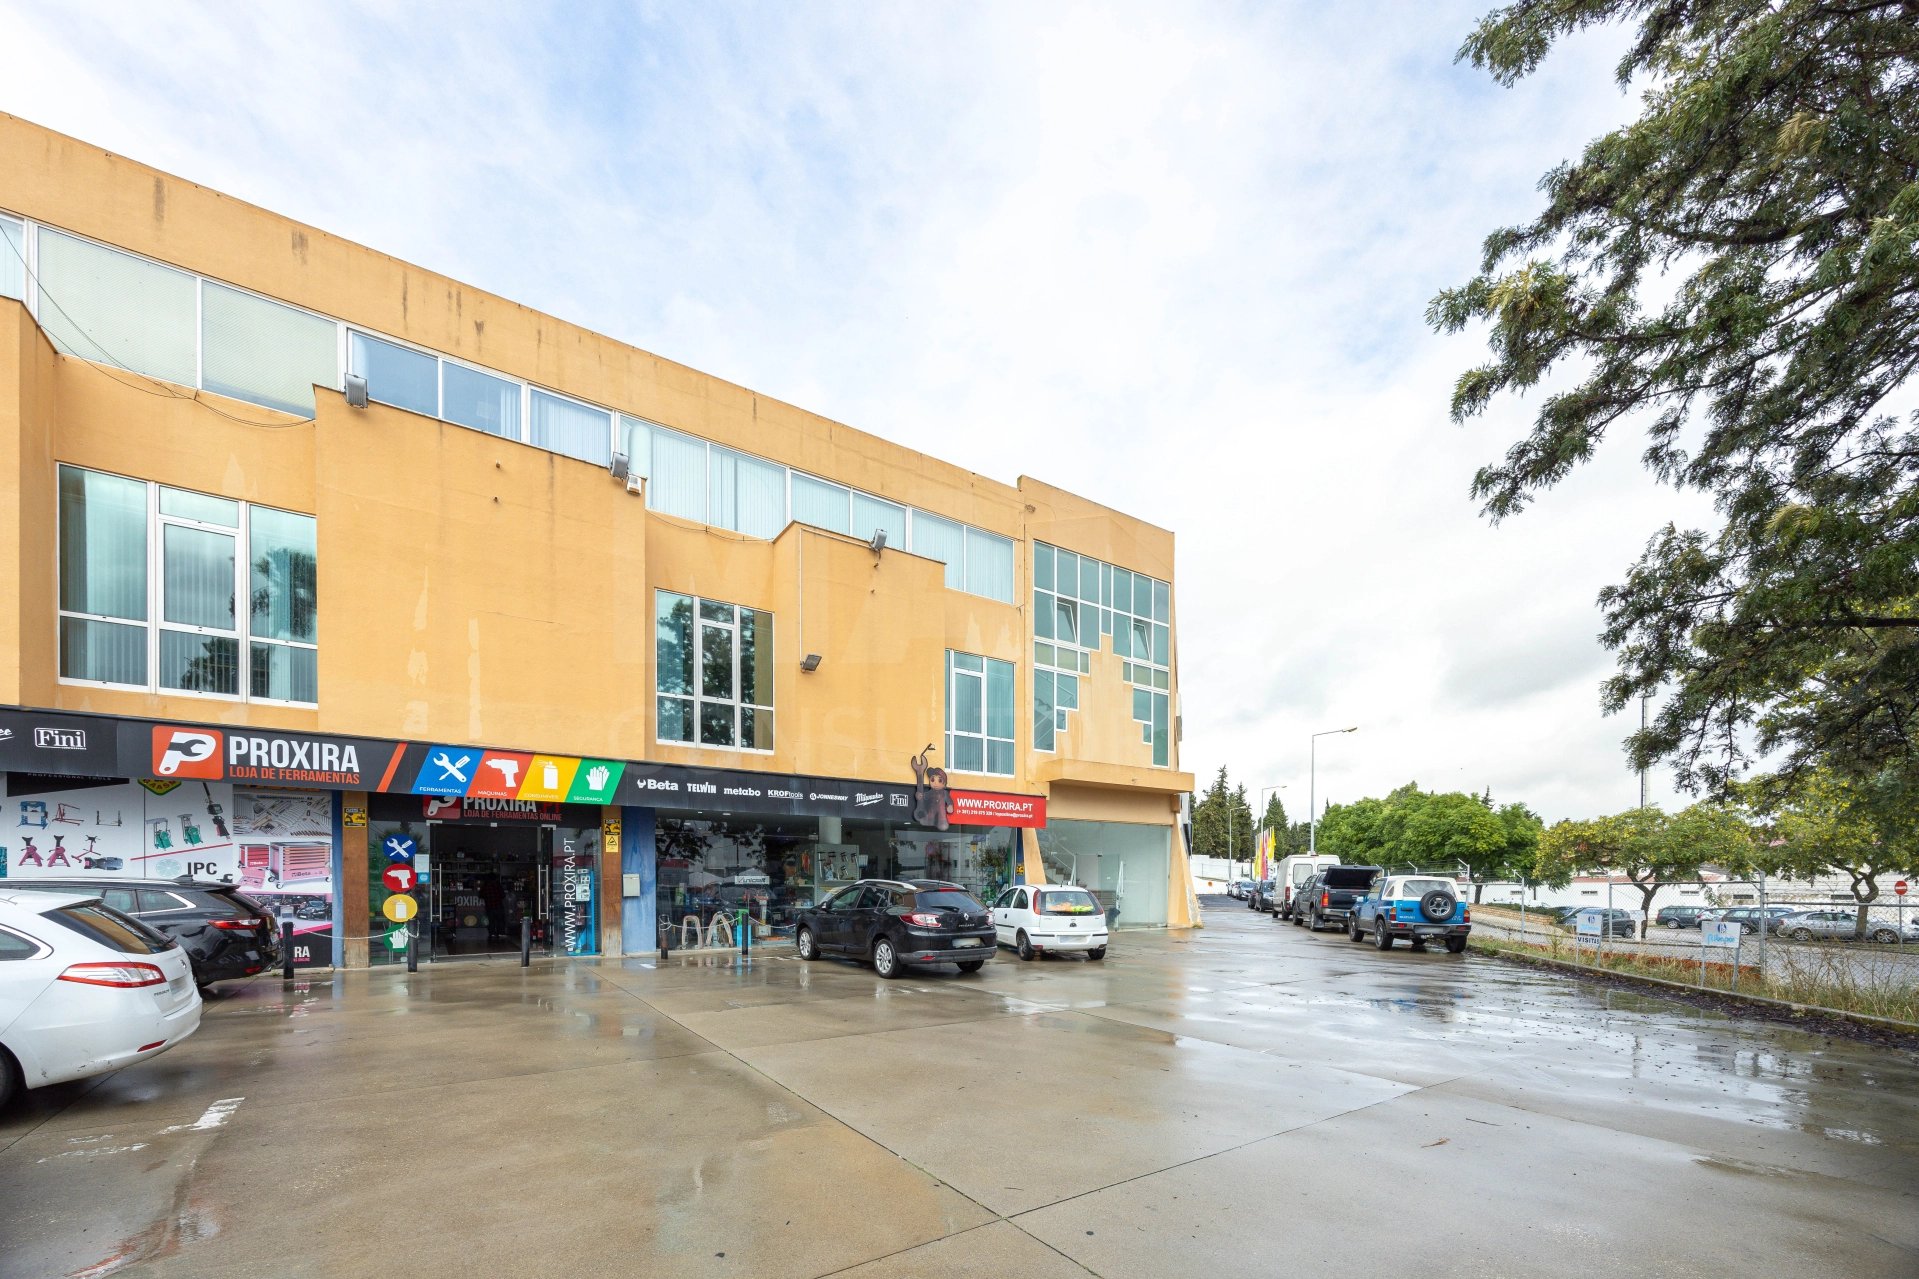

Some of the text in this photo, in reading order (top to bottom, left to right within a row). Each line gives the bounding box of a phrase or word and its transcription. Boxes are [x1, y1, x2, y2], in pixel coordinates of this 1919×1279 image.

[37, 728, 84, 748] Fini
[229, 735, 360, 773] PROXIRA
[229, 766, 360, 785] LOJA DE FERRAMENTAS
[419, 786, 462, 794] FERRAMENTAS
[647, 778, 679, 791] Beta
[687, 781, 717, 794] TELWIN
[723, 787, 761, 797] metabo
[891, 793, 907, 806] Fini
[957, 798, 1033, 812] WWW.PROXIRA.PT
[464, 810, 562, 822] LOJA DE FERRAMENTAS ONLINE
[187, 862, 217, 875] IPC
[564, 838, 576, 948] WWW.PROXIRA.PT
